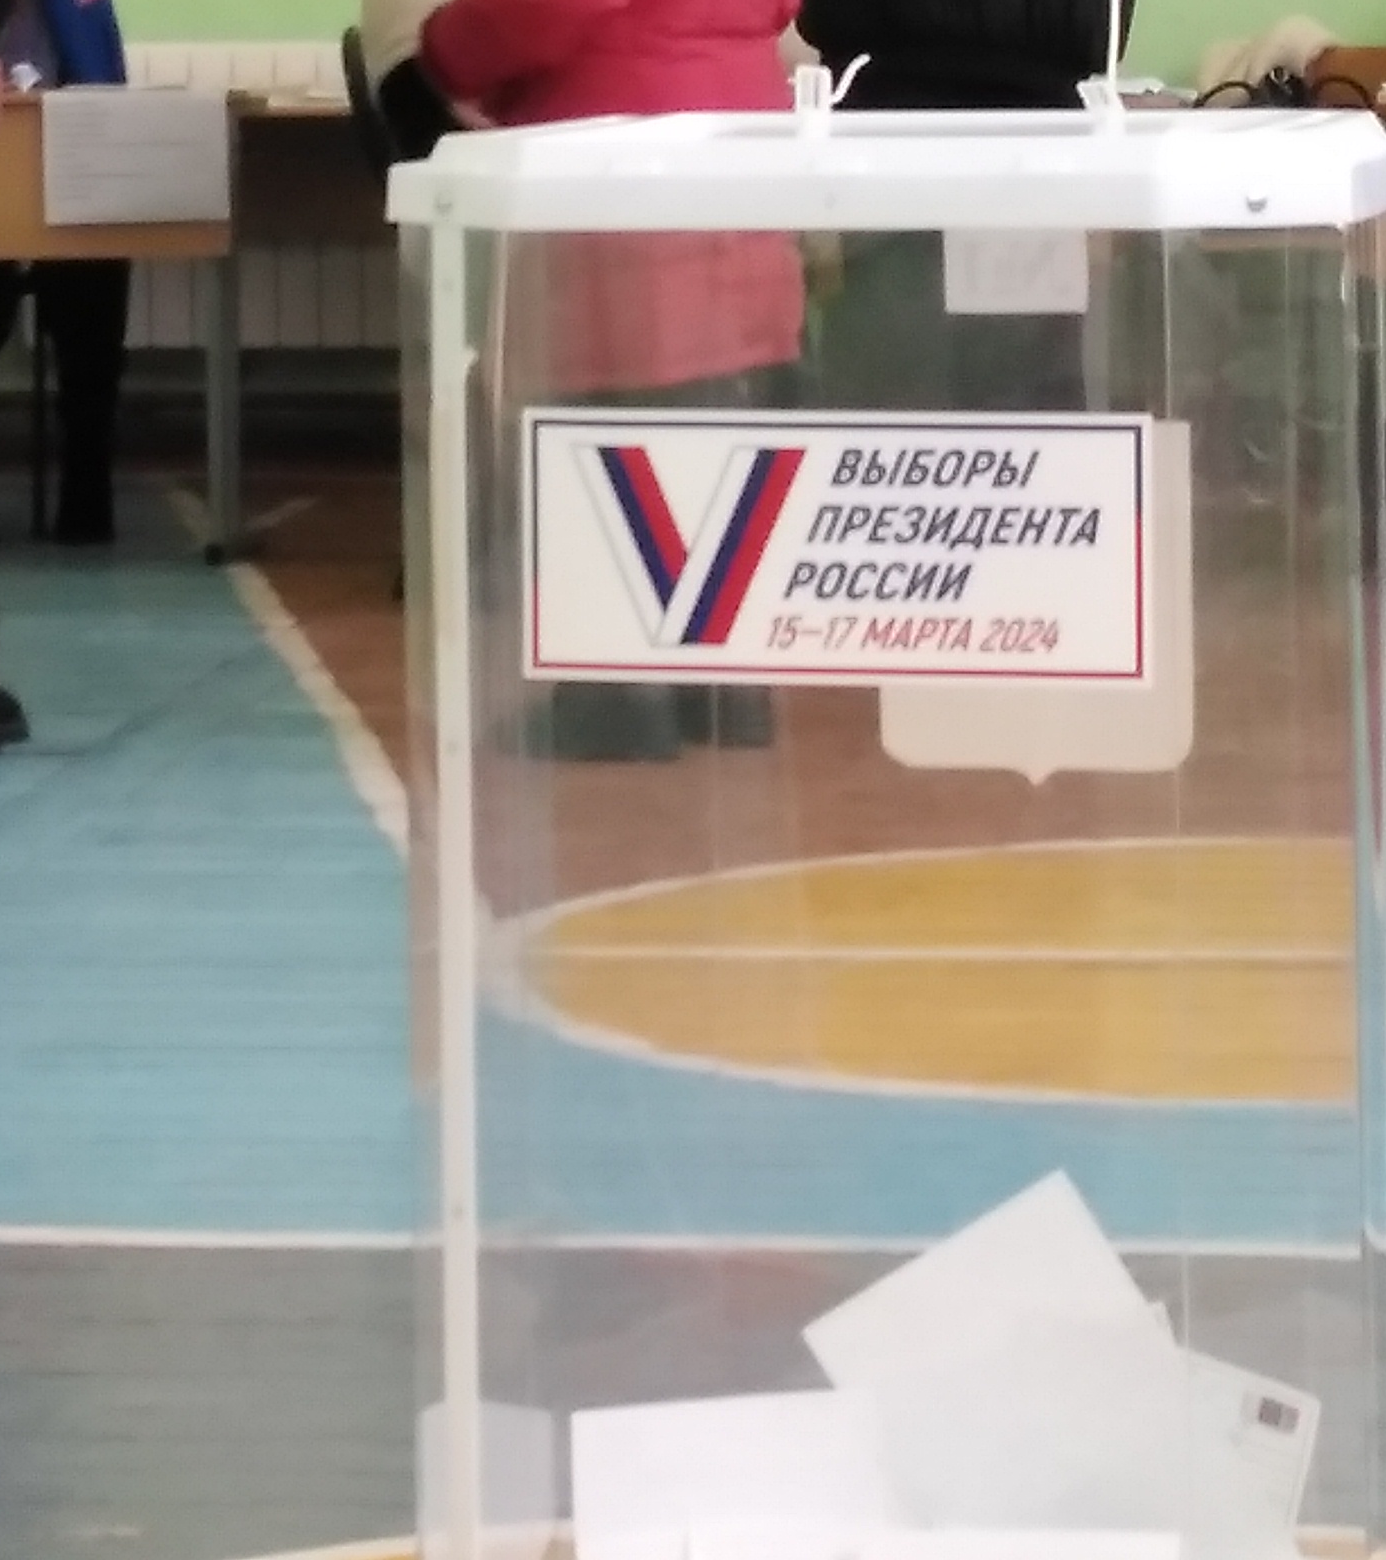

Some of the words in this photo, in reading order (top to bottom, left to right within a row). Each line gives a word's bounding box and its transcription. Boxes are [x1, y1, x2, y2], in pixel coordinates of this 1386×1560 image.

[831, 449, 1040, 487] ВЫБОРЫ
[807, 505, 1101, 550] ПРЕЗИДЕНТА
[783, 562, 973, 601] РОССИИ
[861, 617, 973, 652] МАРТА
[980, 618, 1060, 653] 2024
